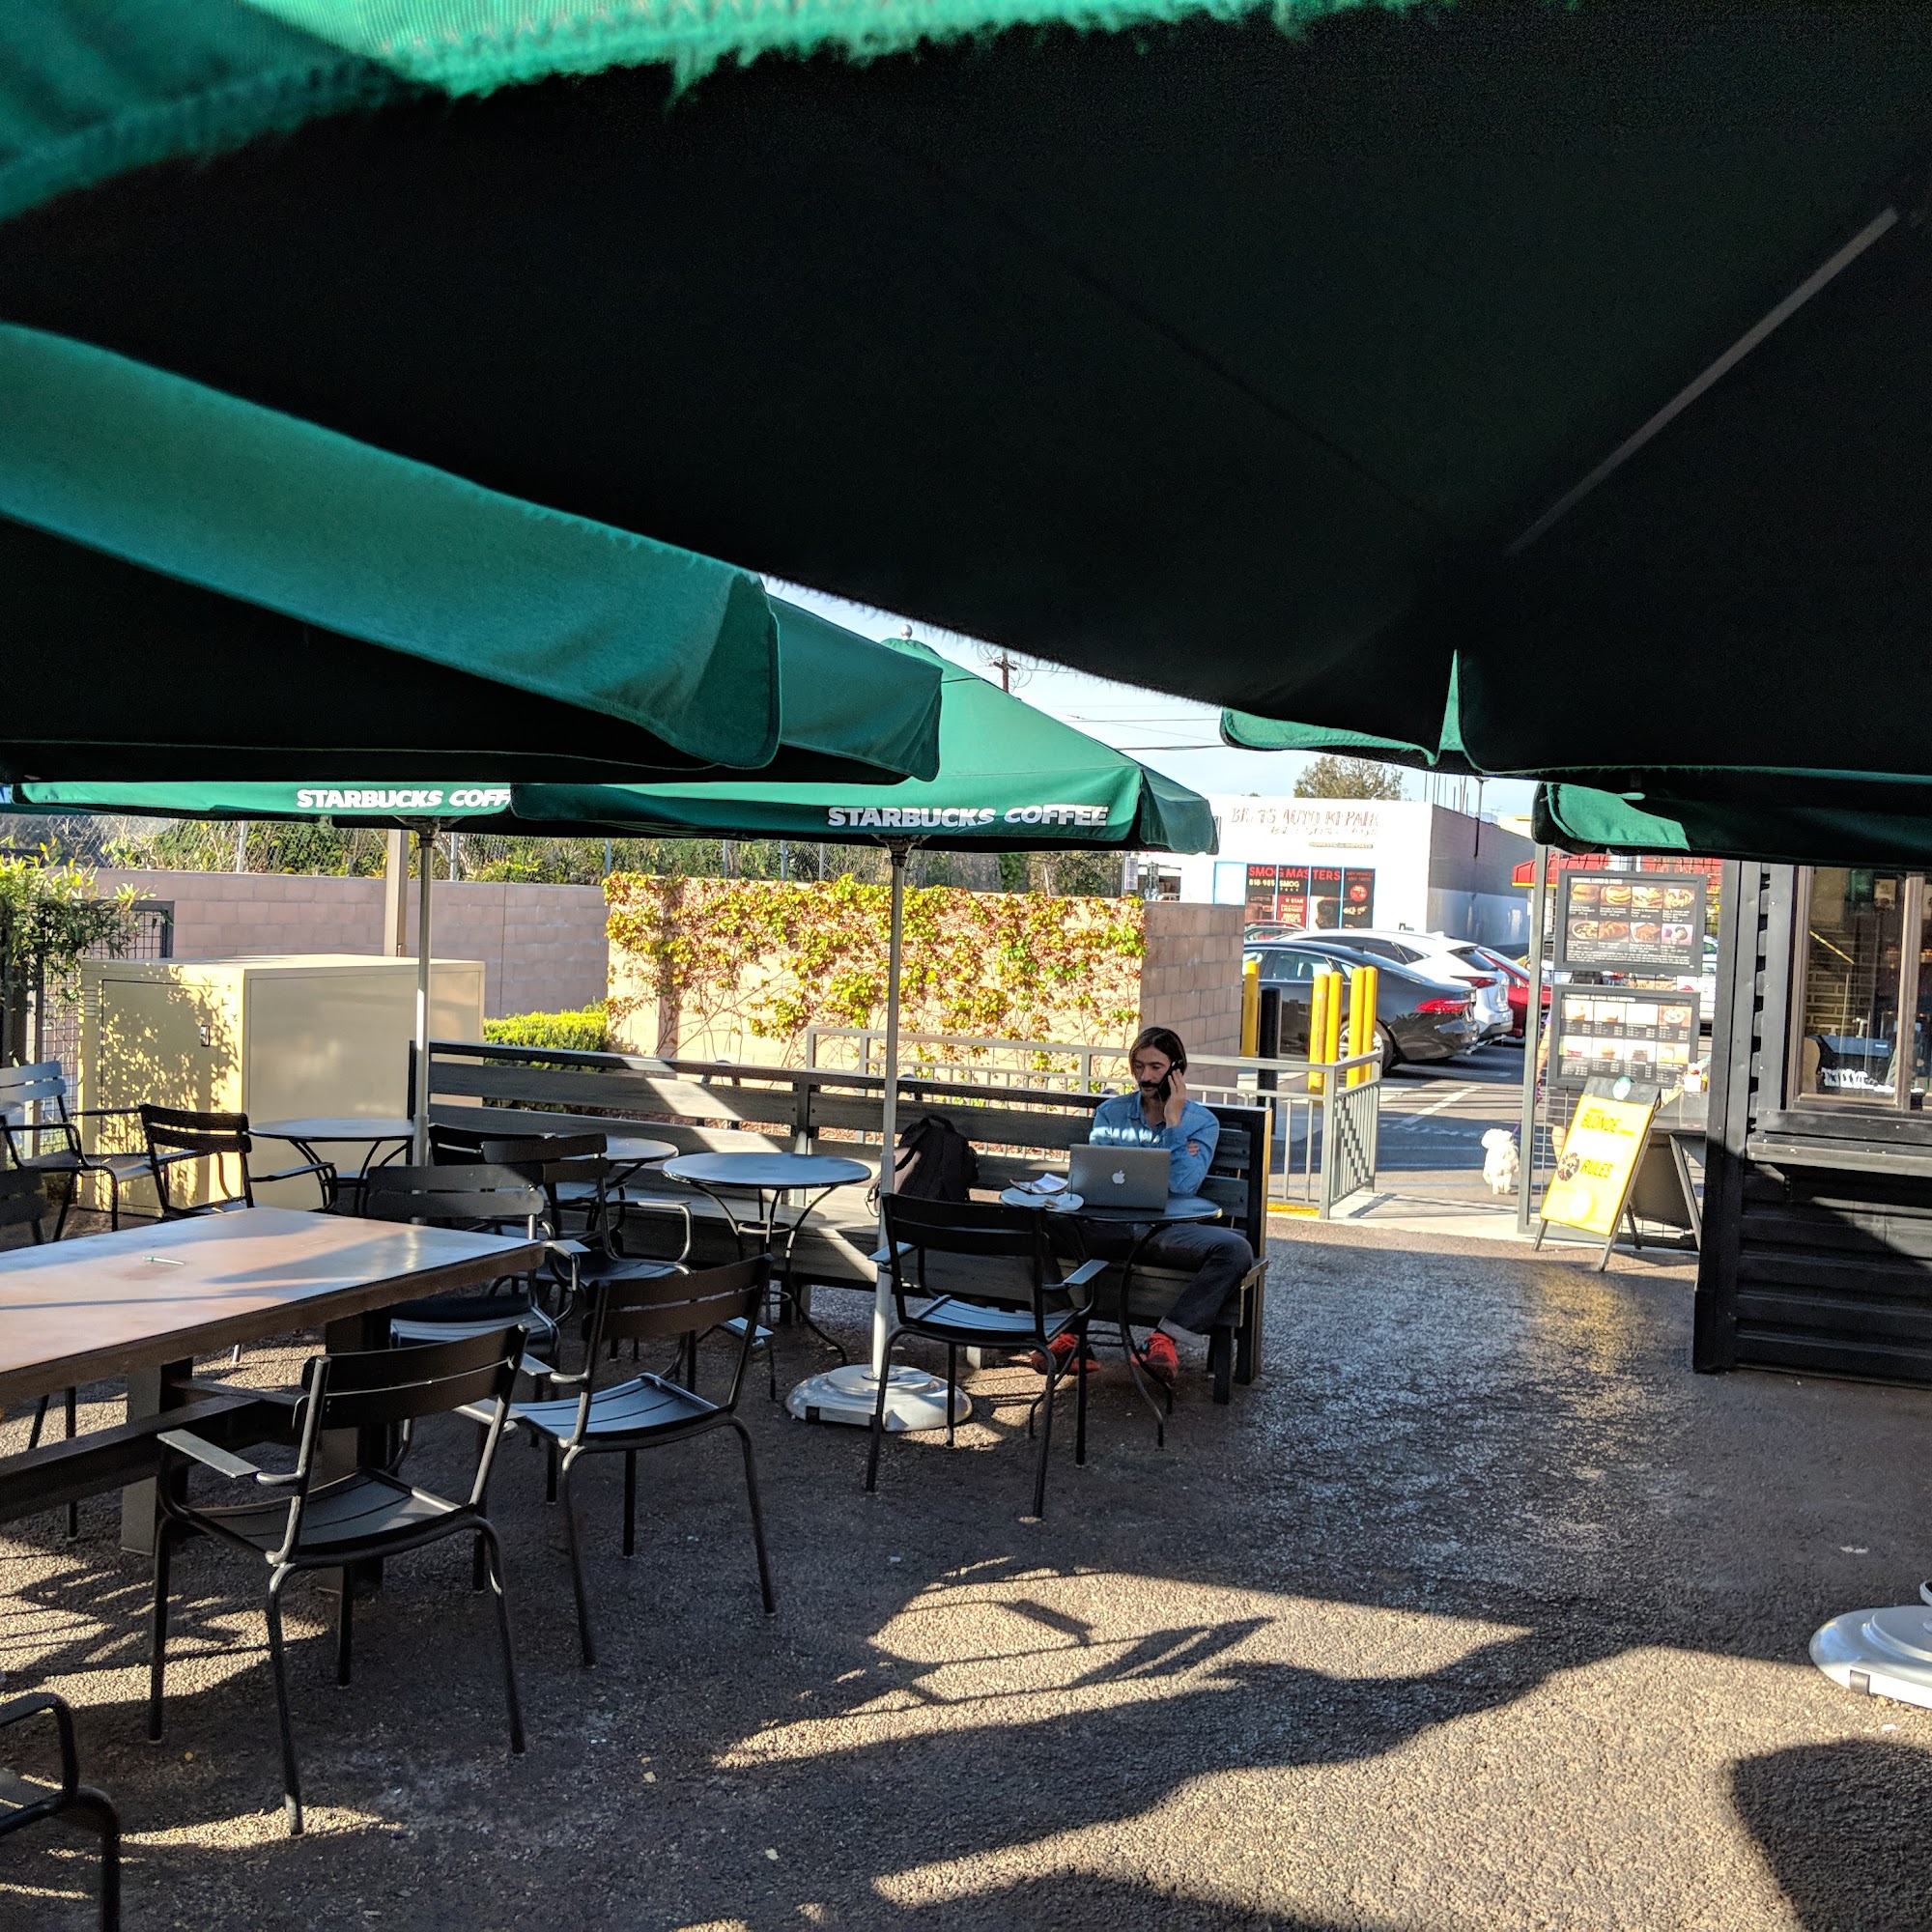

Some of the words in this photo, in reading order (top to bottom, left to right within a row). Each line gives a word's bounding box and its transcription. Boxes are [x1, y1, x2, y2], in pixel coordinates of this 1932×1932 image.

[297, 788, 444, 809] STARBUCKS
[828, 807, 996, 827] STARBUCKS
[1004, 804, 1109, 826] COFFEE
[1248, 867, 1285, 878] SMOG
[1286, 868, 1341, 881] MASTERS
[1580, 1113, 1621, 1133] BLONDE
[1580, 1159, 1613, 1179] RULES
